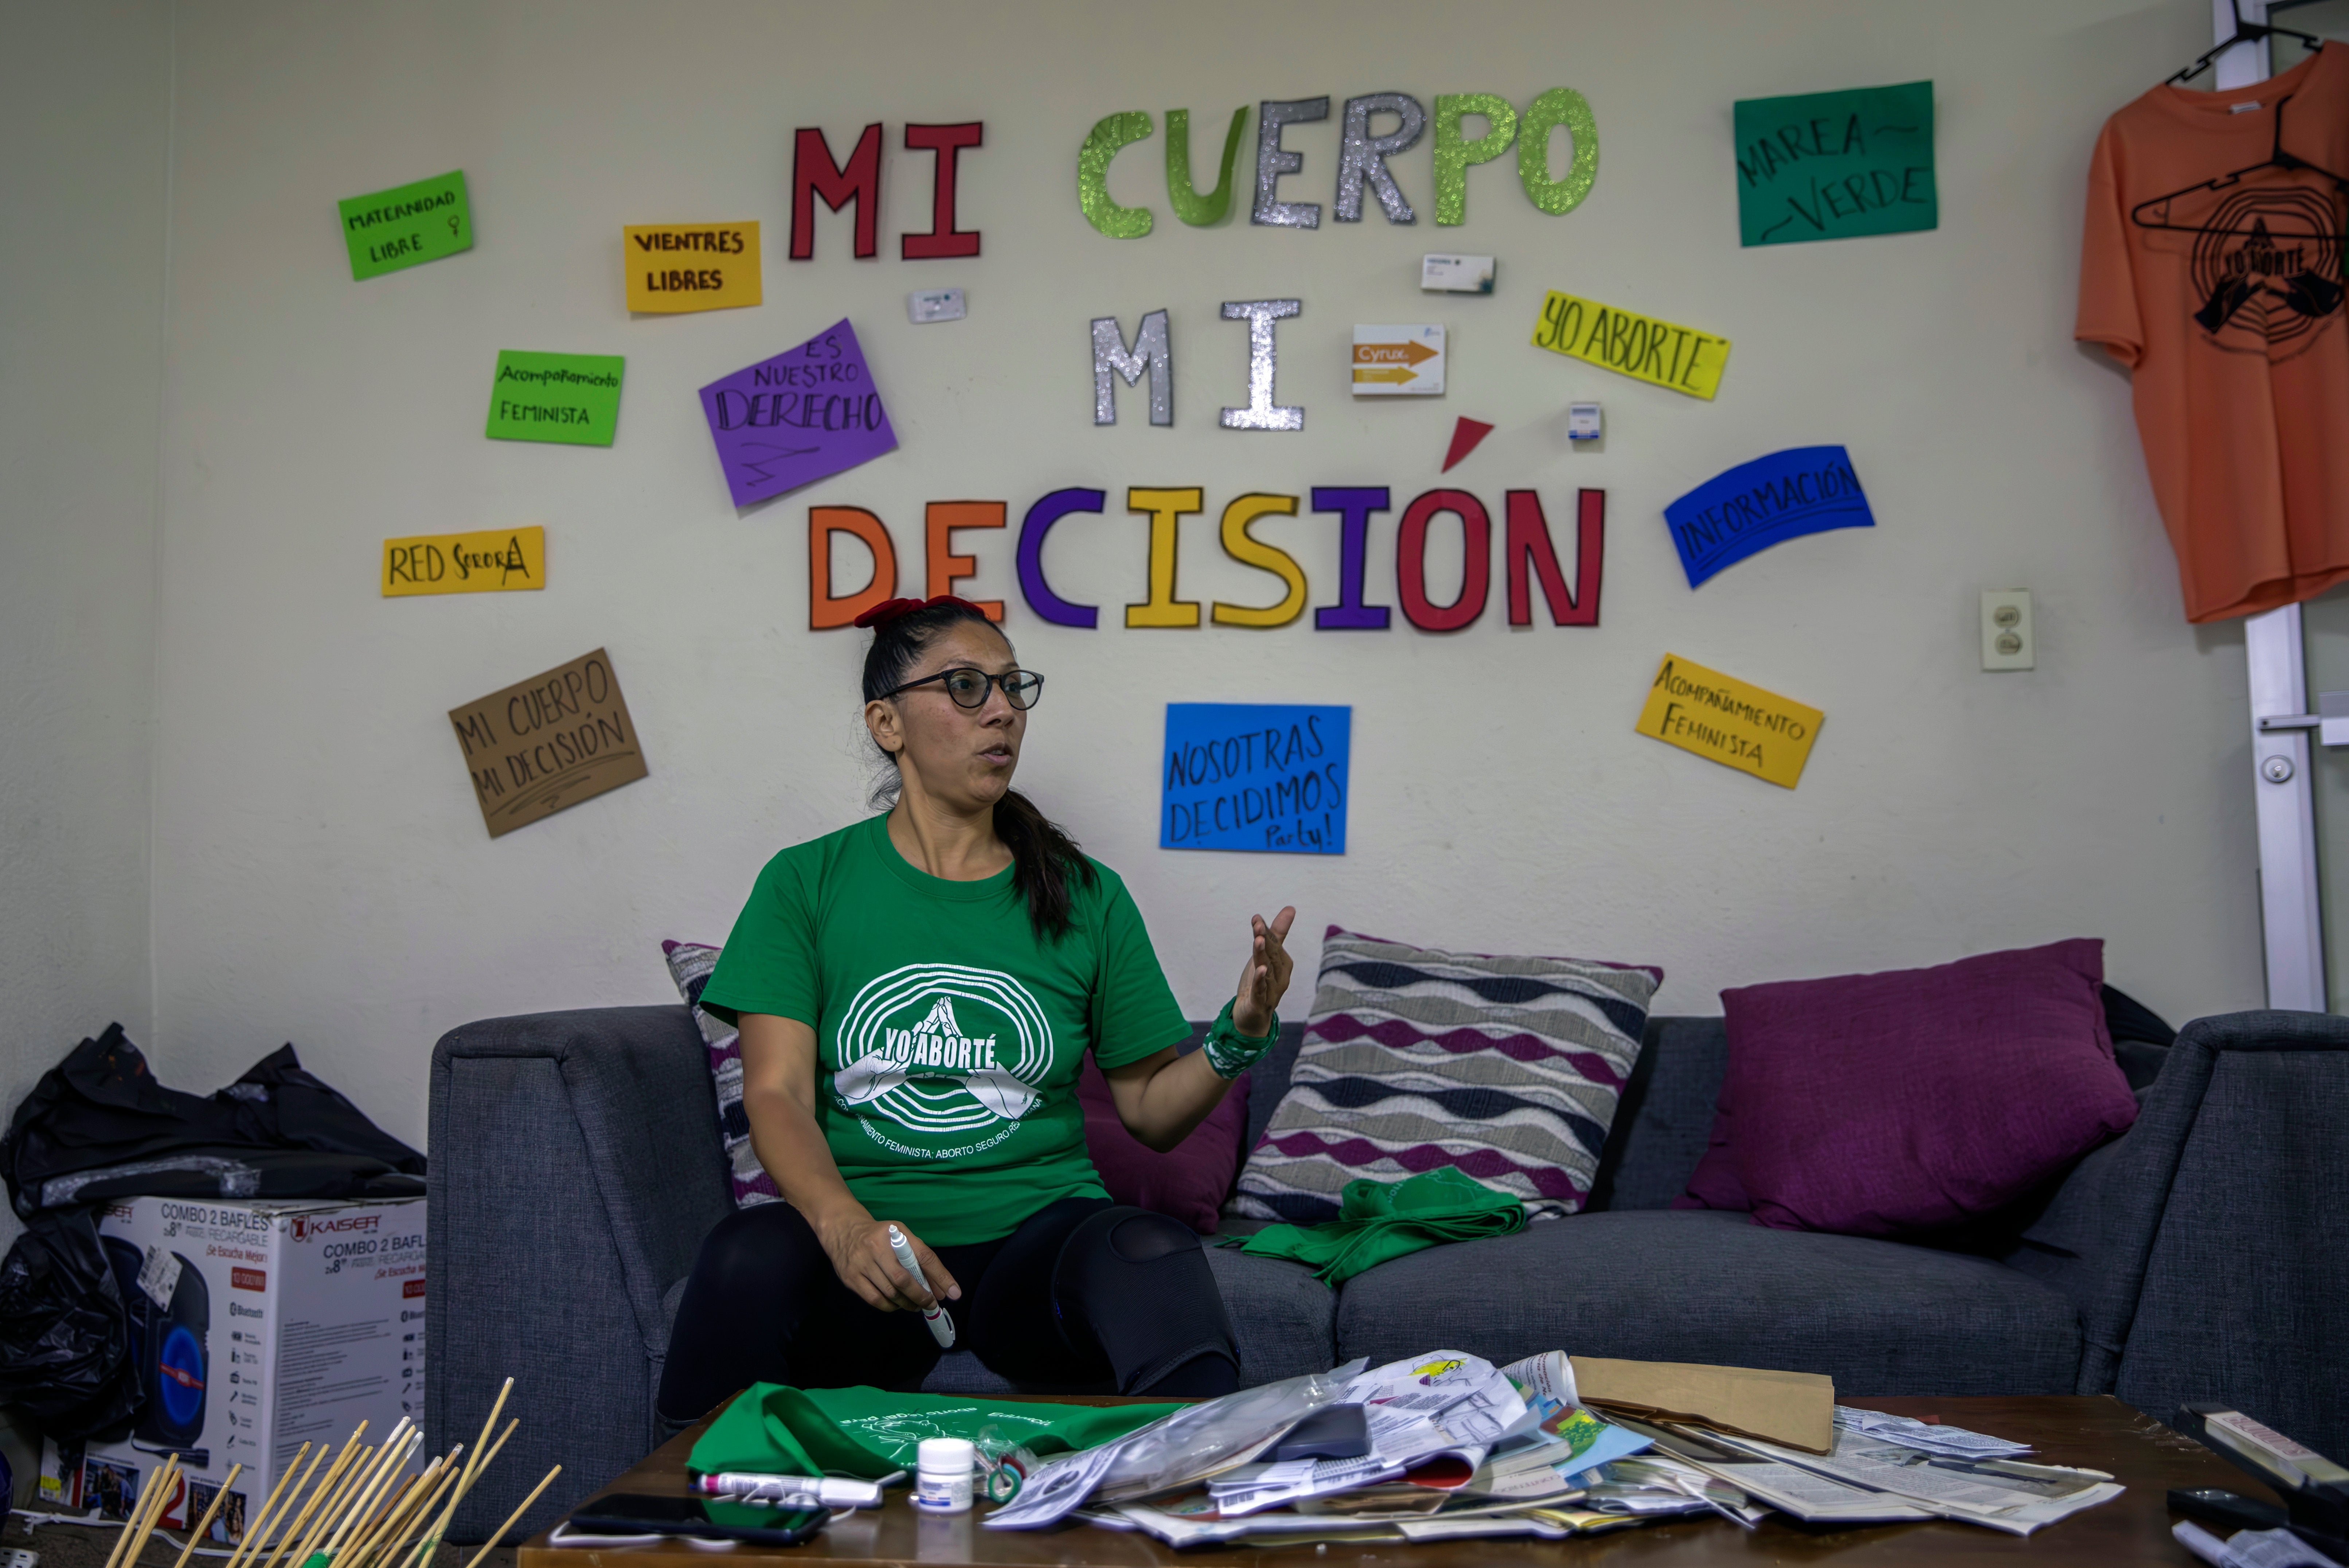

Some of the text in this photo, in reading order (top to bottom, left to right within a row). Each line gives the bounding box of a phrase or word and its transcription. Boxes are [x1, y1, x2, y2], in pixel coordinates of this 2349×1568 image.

[1738, 113, 1866, 188] MAREA
[789, 86, 1599, 260] MI CUERPO
[348, 190, 455, 231] MATERNIDAD
[1787, 166, 1932, 231] VERDE
[370, 233, 423, 263] LIBRE
[633, 230, 745, 254] VIENTRES
[646, 269, 723, 291] LIBRES
[1537, 296, 1583, 351] YO
[805, 335, 842, 359] ES
[1090, 299, 1304, 431] MI
[1359, 345, 1406, 363] Cyrux
[754, 363, 859, 388] NUESTRO
[500, 399, 590, 425] FEMINISTA
[716, 389, 883, 431] DERECHO
[808, 416, 1605, 631] DECISIÓN
[1679, 460, 1862, 560] INFORMACIÓN
[390, 544, 445, 585] RED
[456, 660, 607, 755] MI CUERPO
[1168, 714, 1324, 791] NOSOTRAS
[1660, 701, 1763, 768] FEMINISTA
[472, 711, 625, 804] MI DECISIÓN
[1170, 762, 1341, 842] DECIDIMOS
[883, 1027, 996, 1070] YO ABORTÉ
[834, 1096, 885, 1144] ACOAÑAMIENTO
[935, 1146, 974, 1158] ABORTO
[975, 1130, 1009, 1151] SEGURO
[161, 1203, 269, 1231] COMBO 2 BAFLES
[310, 1215, 382, 1235] KAISER
[324, 1234, 427, 1259] COMBO 2 BAFL
[926, 1407, 977, 1415] aborto
